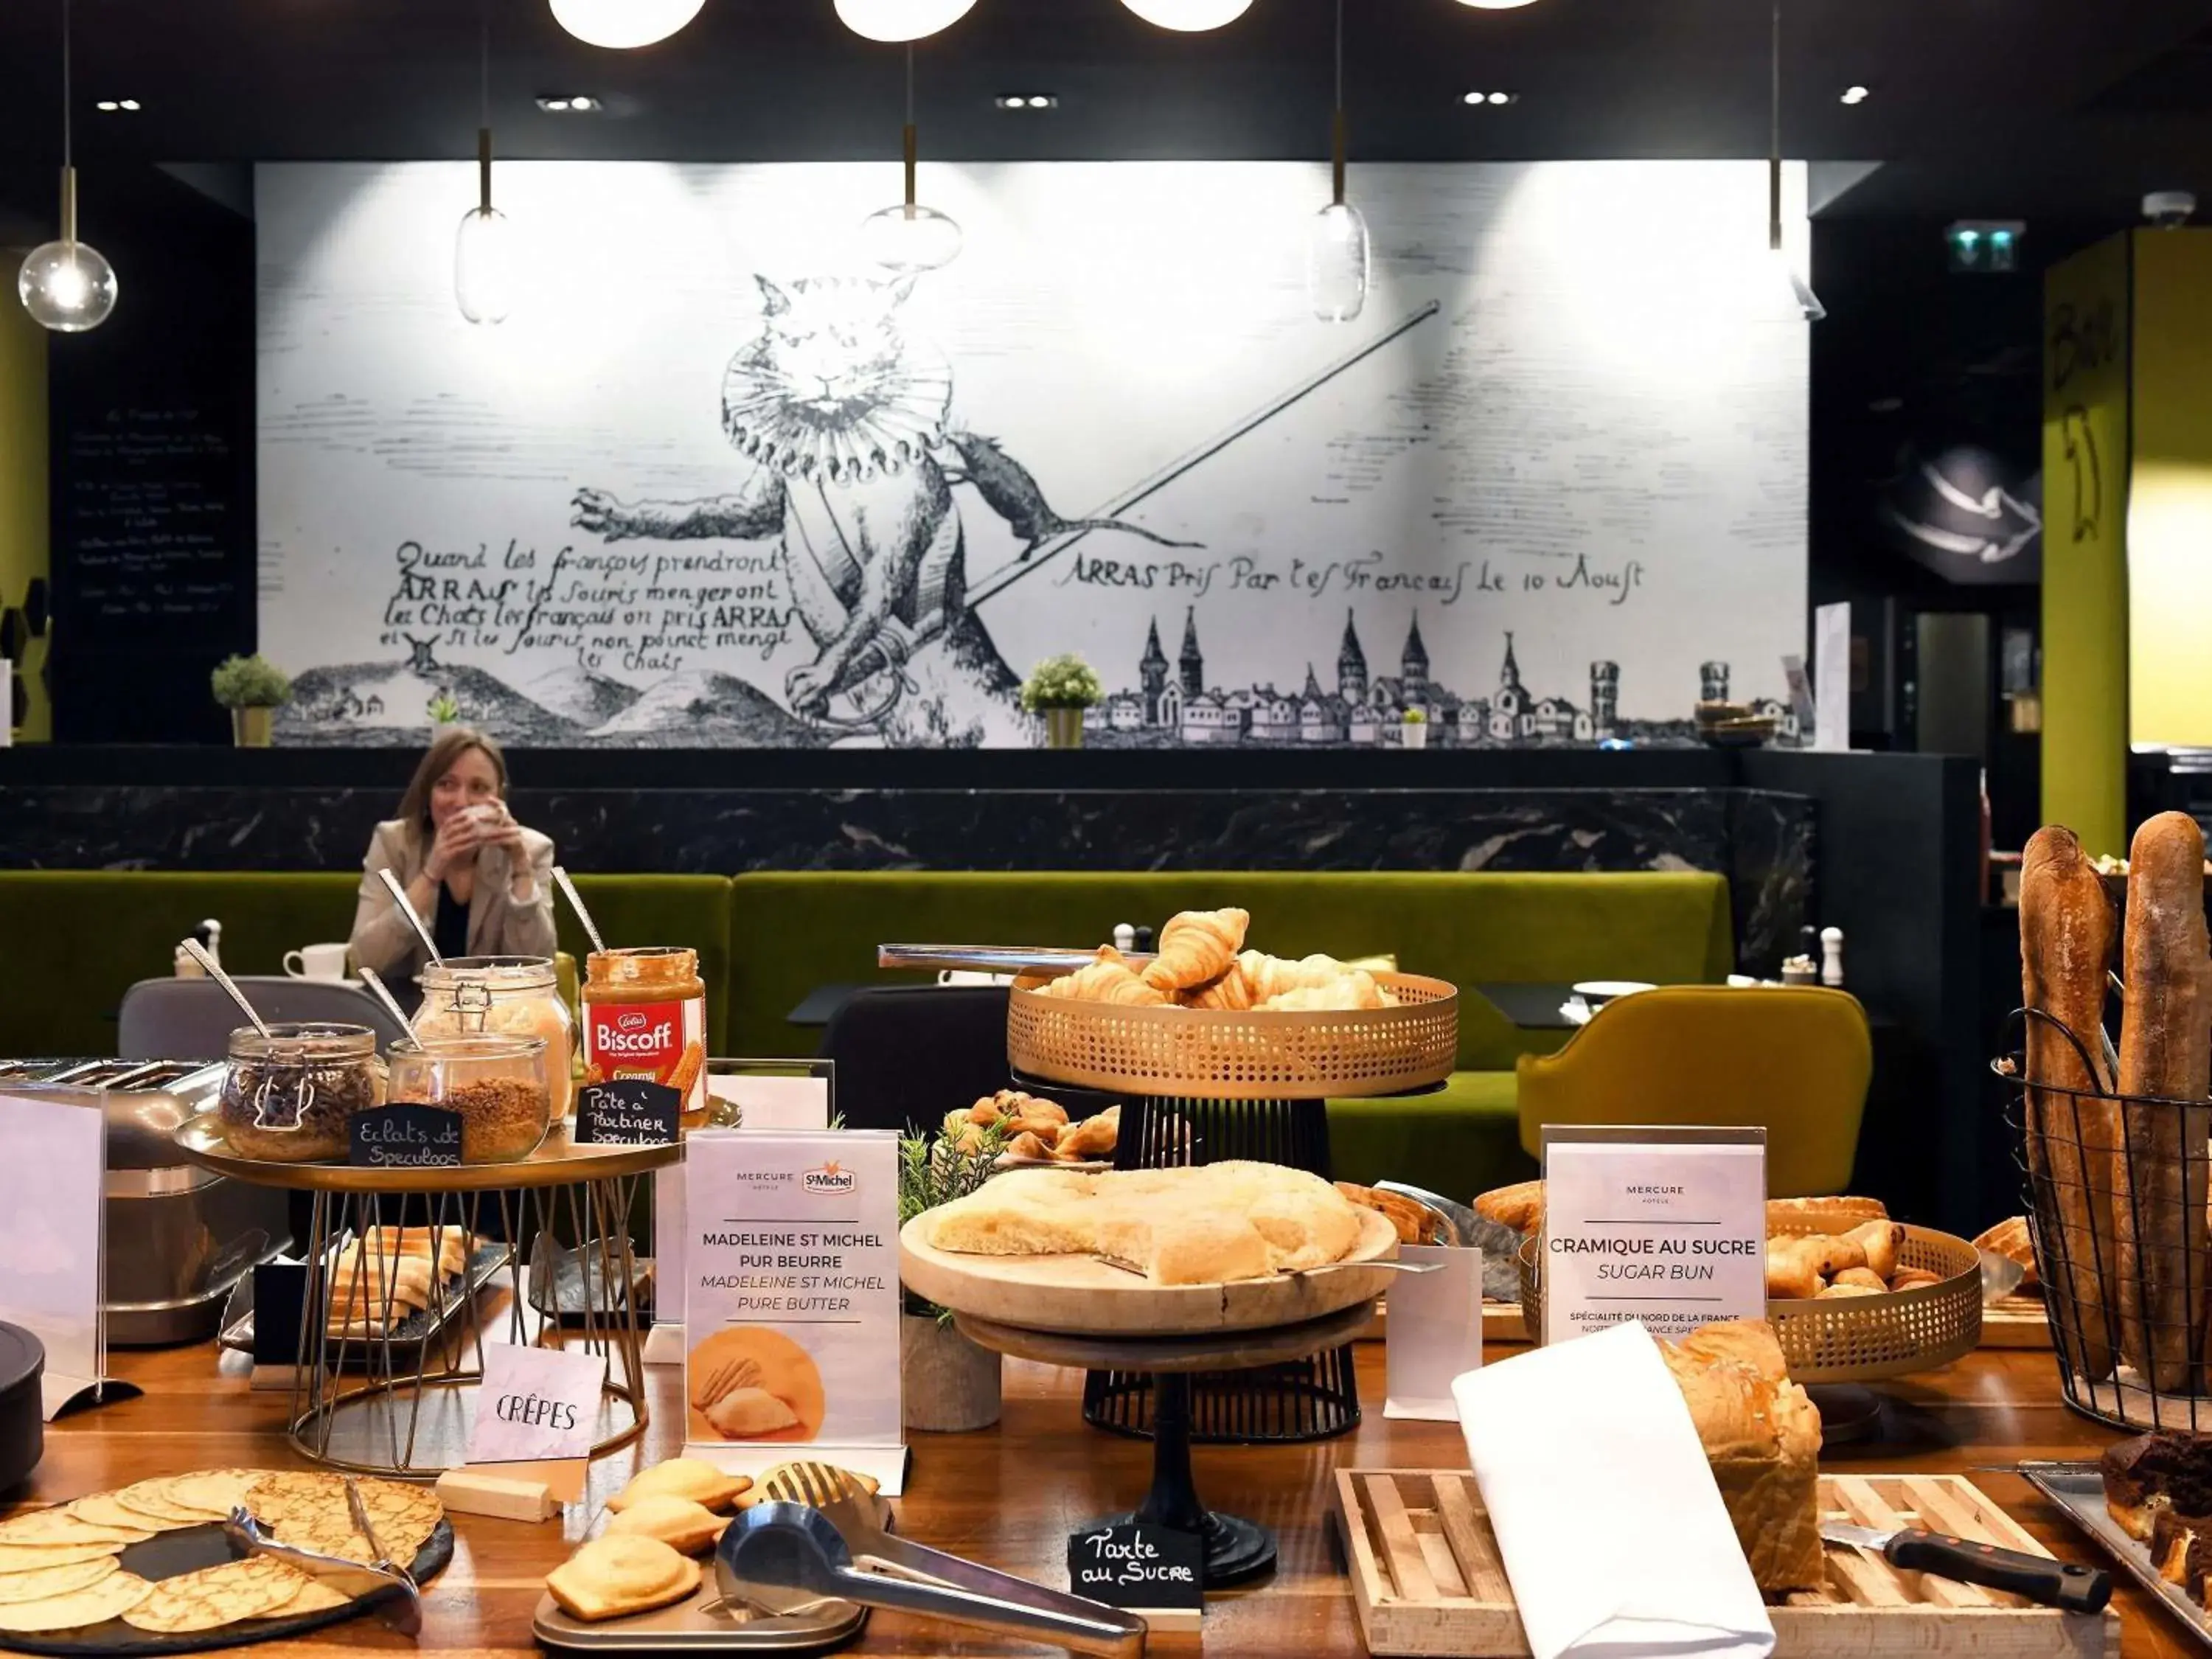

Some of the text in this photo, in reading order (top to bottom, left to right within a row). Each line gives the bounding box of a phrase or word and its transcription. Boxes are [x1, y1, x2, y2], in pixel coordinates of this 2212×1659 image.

[397, 541, 487, 577] Quand
[504, 538, 535, 569] les
[1052, 552, 1158, 588] ARRAS
[1230, 556, 1280, 591] Par
[1477, 559, 1505, 591] Le
[1523, 574, 1545, 591] 10
[592, 635, 633, 650] non
[597, 1022, 672, 1051] Biscoff
[613, 1070, 655, 1082] Creamy
[361, 1119, 428, 1143] Eclats
[369, 1144, 460, 1167] Speculoos
[737, 1173, 795, 1181] MERCURE
[1627, 1186, 1685, 1194] MERCURE
[703, 1234, 883, 1248] MADELEINE ST MICHEL
[1550, 1238, 1756, 1255] CRAMIQUE AU SUCRE
[740, 1255, 842, 1268] PUR BEURRE
[1596, 1264, 1714, 1280] SUGAR BUN
[700, 1276, 886, 1290] MADELEINE ST MICHEL
[738, 1297, 850, 1311] PURE BUTTER
[1641, 1313, 1670, 1322] NORD
[1672, 1314, 1686, 1322] DE
[1688, 1314, 1699, 1322] LA
[496, 1393, 577, 1430] CRÊPES
[1085, 1528, 1160, 1559] Tarte
[1082, 1567, 1113, 1582] au
